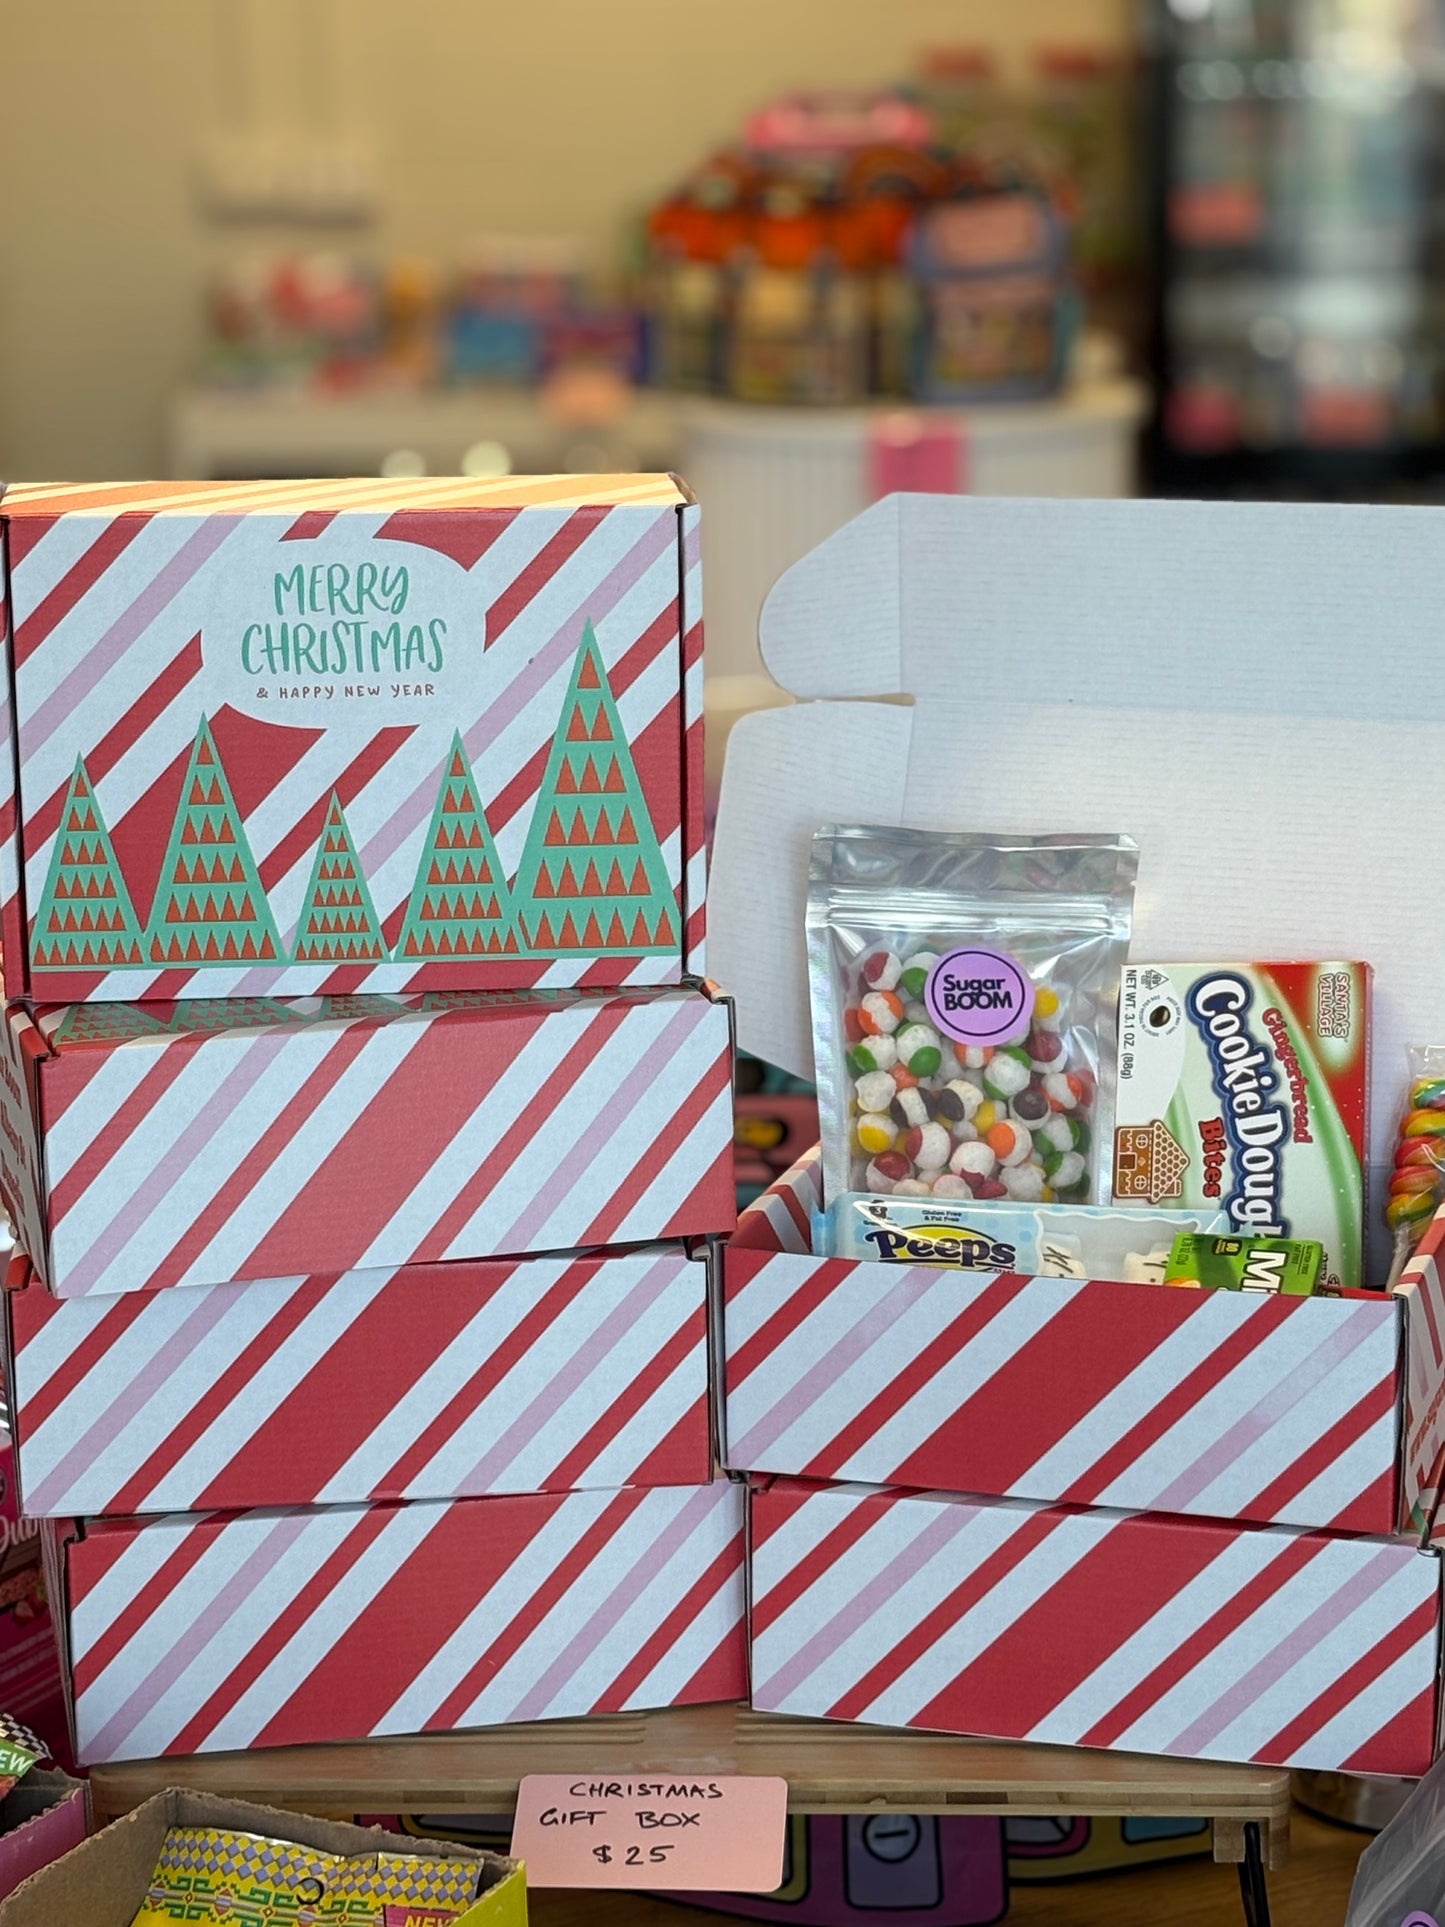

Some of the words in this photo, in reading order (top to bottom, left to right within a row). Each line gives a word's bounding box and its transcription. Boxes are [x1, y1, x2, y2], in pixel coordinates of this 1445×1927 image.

[274, 562, 409, 616] MERRY
[241, 618, 447, 675] CHRISTMAS
[256, 687, 269, 699] &
[279, 685, 335, 699] HAPPY
[344, 685, 381, 697] NEW
[391, 683, 435, 698] YEAR
[943, 974, 1006, 994] Sugar
[1126, 969, 1137, 990] NET
[943, 991, 1013, 1011] BOOM
[1318, 973, 1334, 1038] VILLAGE
[1333, 972, 1350, 1039] SANTA'S
[1124, 1013, 1136, 1029] 3.1
[1120, 1053, 1134, 1080] (88g)
[1262, 1008, 1313, 1143] Gingerbread
[1198, 1117, 1228, 1198] Bites
[864, 1230, 1016, 1267] Peeps
[569, 1782, 723, 1799] CHRISTMAS
[539, 1807, 607, 1826] GIFT
[634, 1810, 701, 1829] BOX
